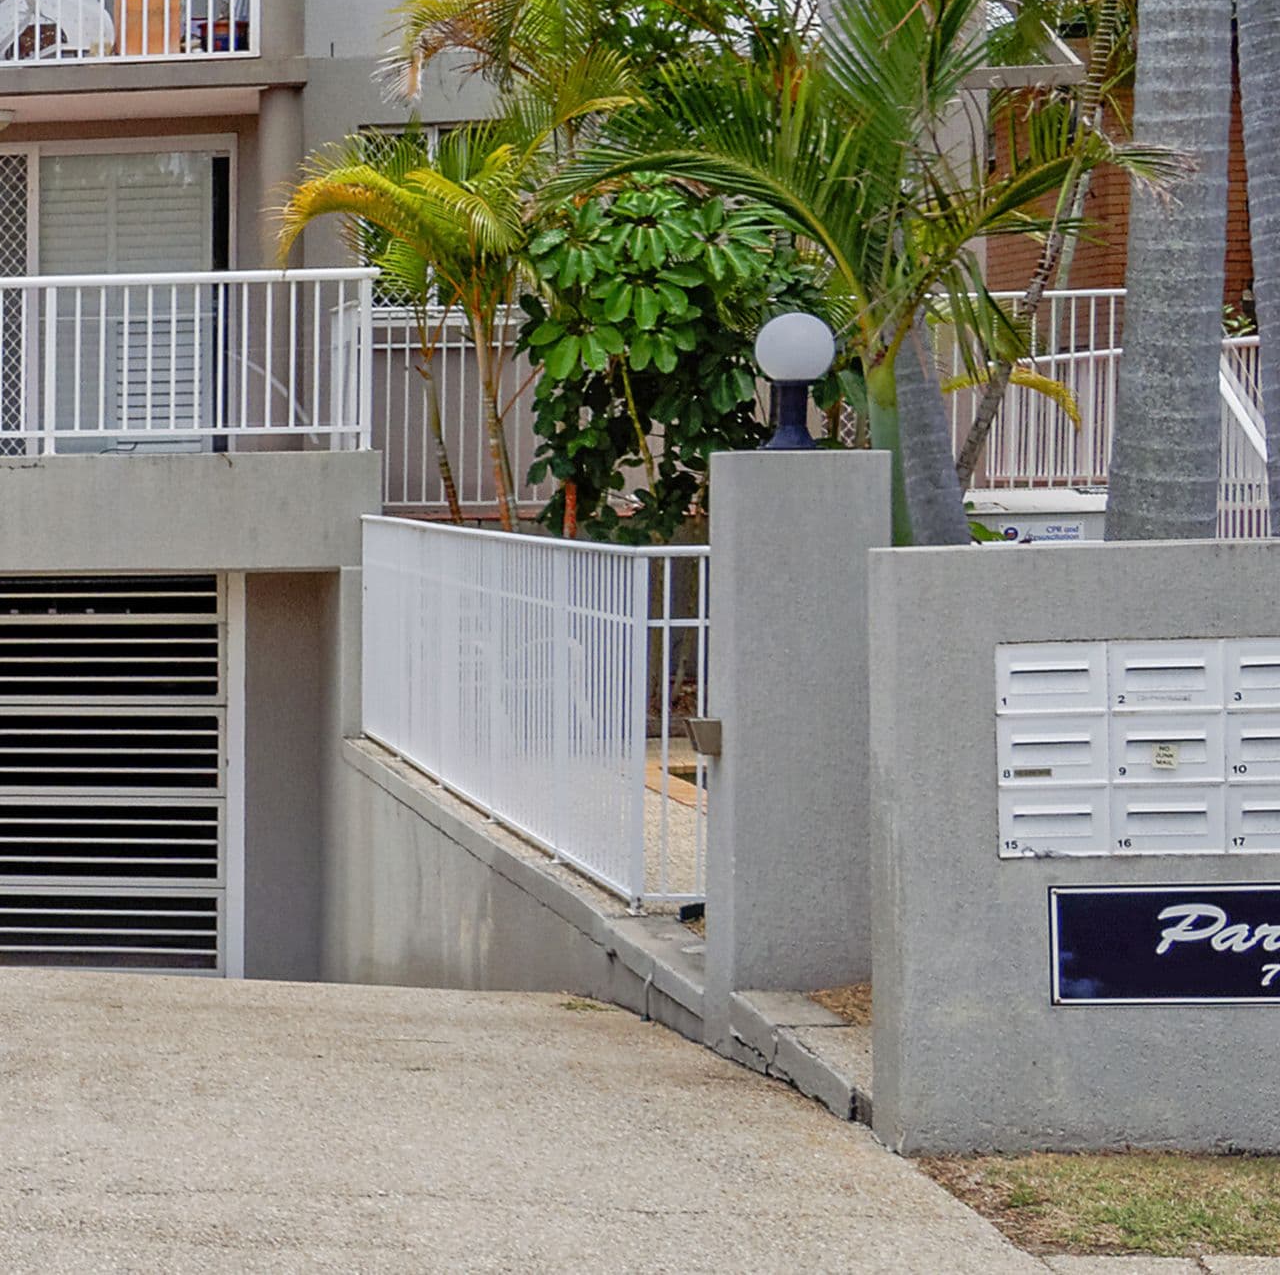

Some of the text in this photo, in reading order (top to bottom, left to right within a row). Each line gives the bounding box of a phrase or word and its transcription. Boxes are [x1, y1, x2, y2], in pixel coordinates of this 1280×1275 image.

[1117, 694, 1126, 704] 2
[1233, 691, 1242, 701] 3
[1001, 697, 1007, 706] 1
[1003, 769, 1011, 778] 8
[1118, 766, 1127, 776] 9
[1232, 764, 1247, 774] 10
[1004, 840, 1018, 850] 15
[1117, 838, 1132, 848] 16
[1232, 836, 1246, 846] 17
